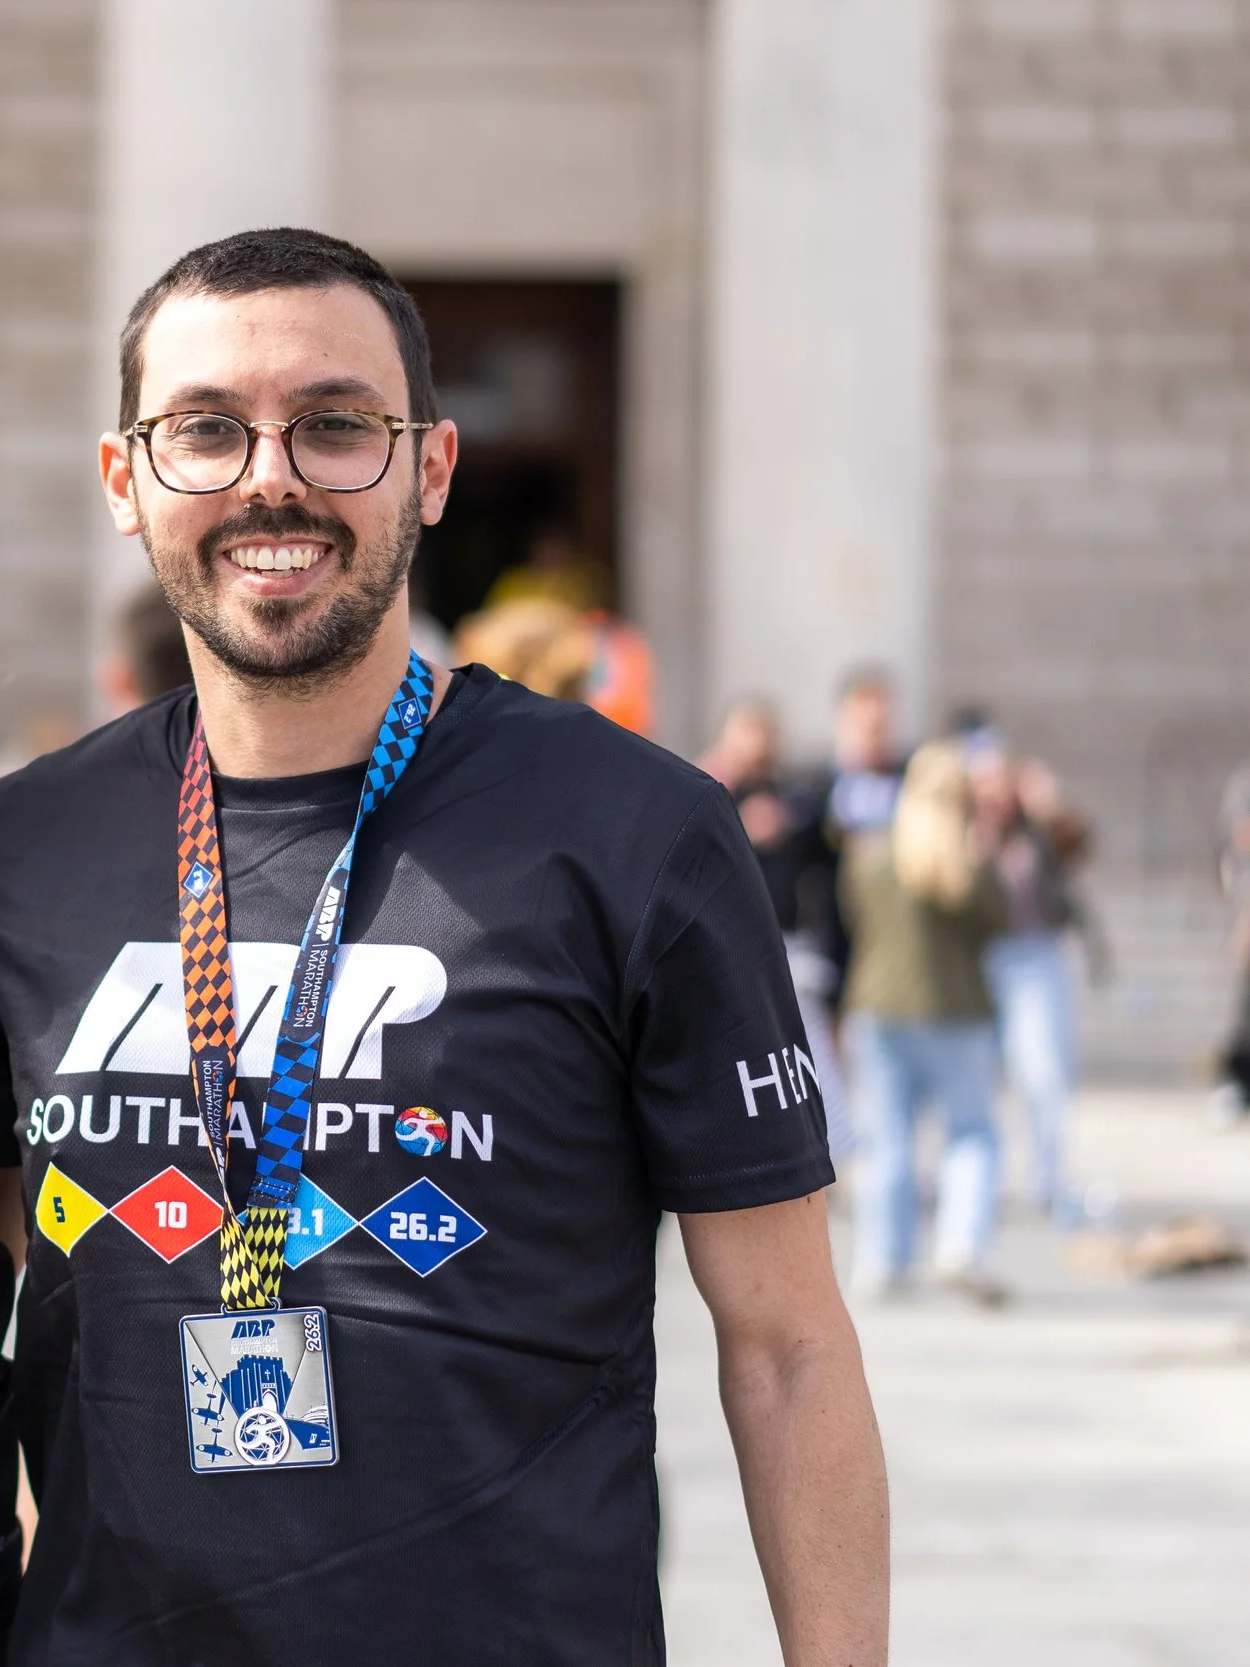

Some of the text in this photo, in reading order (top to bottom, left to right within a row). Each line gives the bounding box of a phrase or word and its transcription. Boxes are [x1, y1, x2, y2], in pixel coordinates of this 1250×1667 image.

[403, 703, 416, 724] 26.2
[315, 886, 341, 942] ABP
[293, 950, 320, 1028] MARATHON
[304, 949, 328, 1028] SOUTHAMPTON
[202, 1060, 216, 1138] SOUTHAMPTON
[212, 1060, 223, 1140] MARATHON
[736, 1043, 822, 1118] HEN
[26, 1095, 494, 1162] SOUTHAPTON
[53, 1197, 66, 1223] 5
[154, 1201, 187, 1228] 10
[286, 1208, 324, 1236] 3.1
[390, 1212, 458, 1243] 26.2
[230, 1319, 276, 1339] ABP
[303, 1313, 322, 1352] 26.2
[230, 1344, 279, 1355] MARATHON
